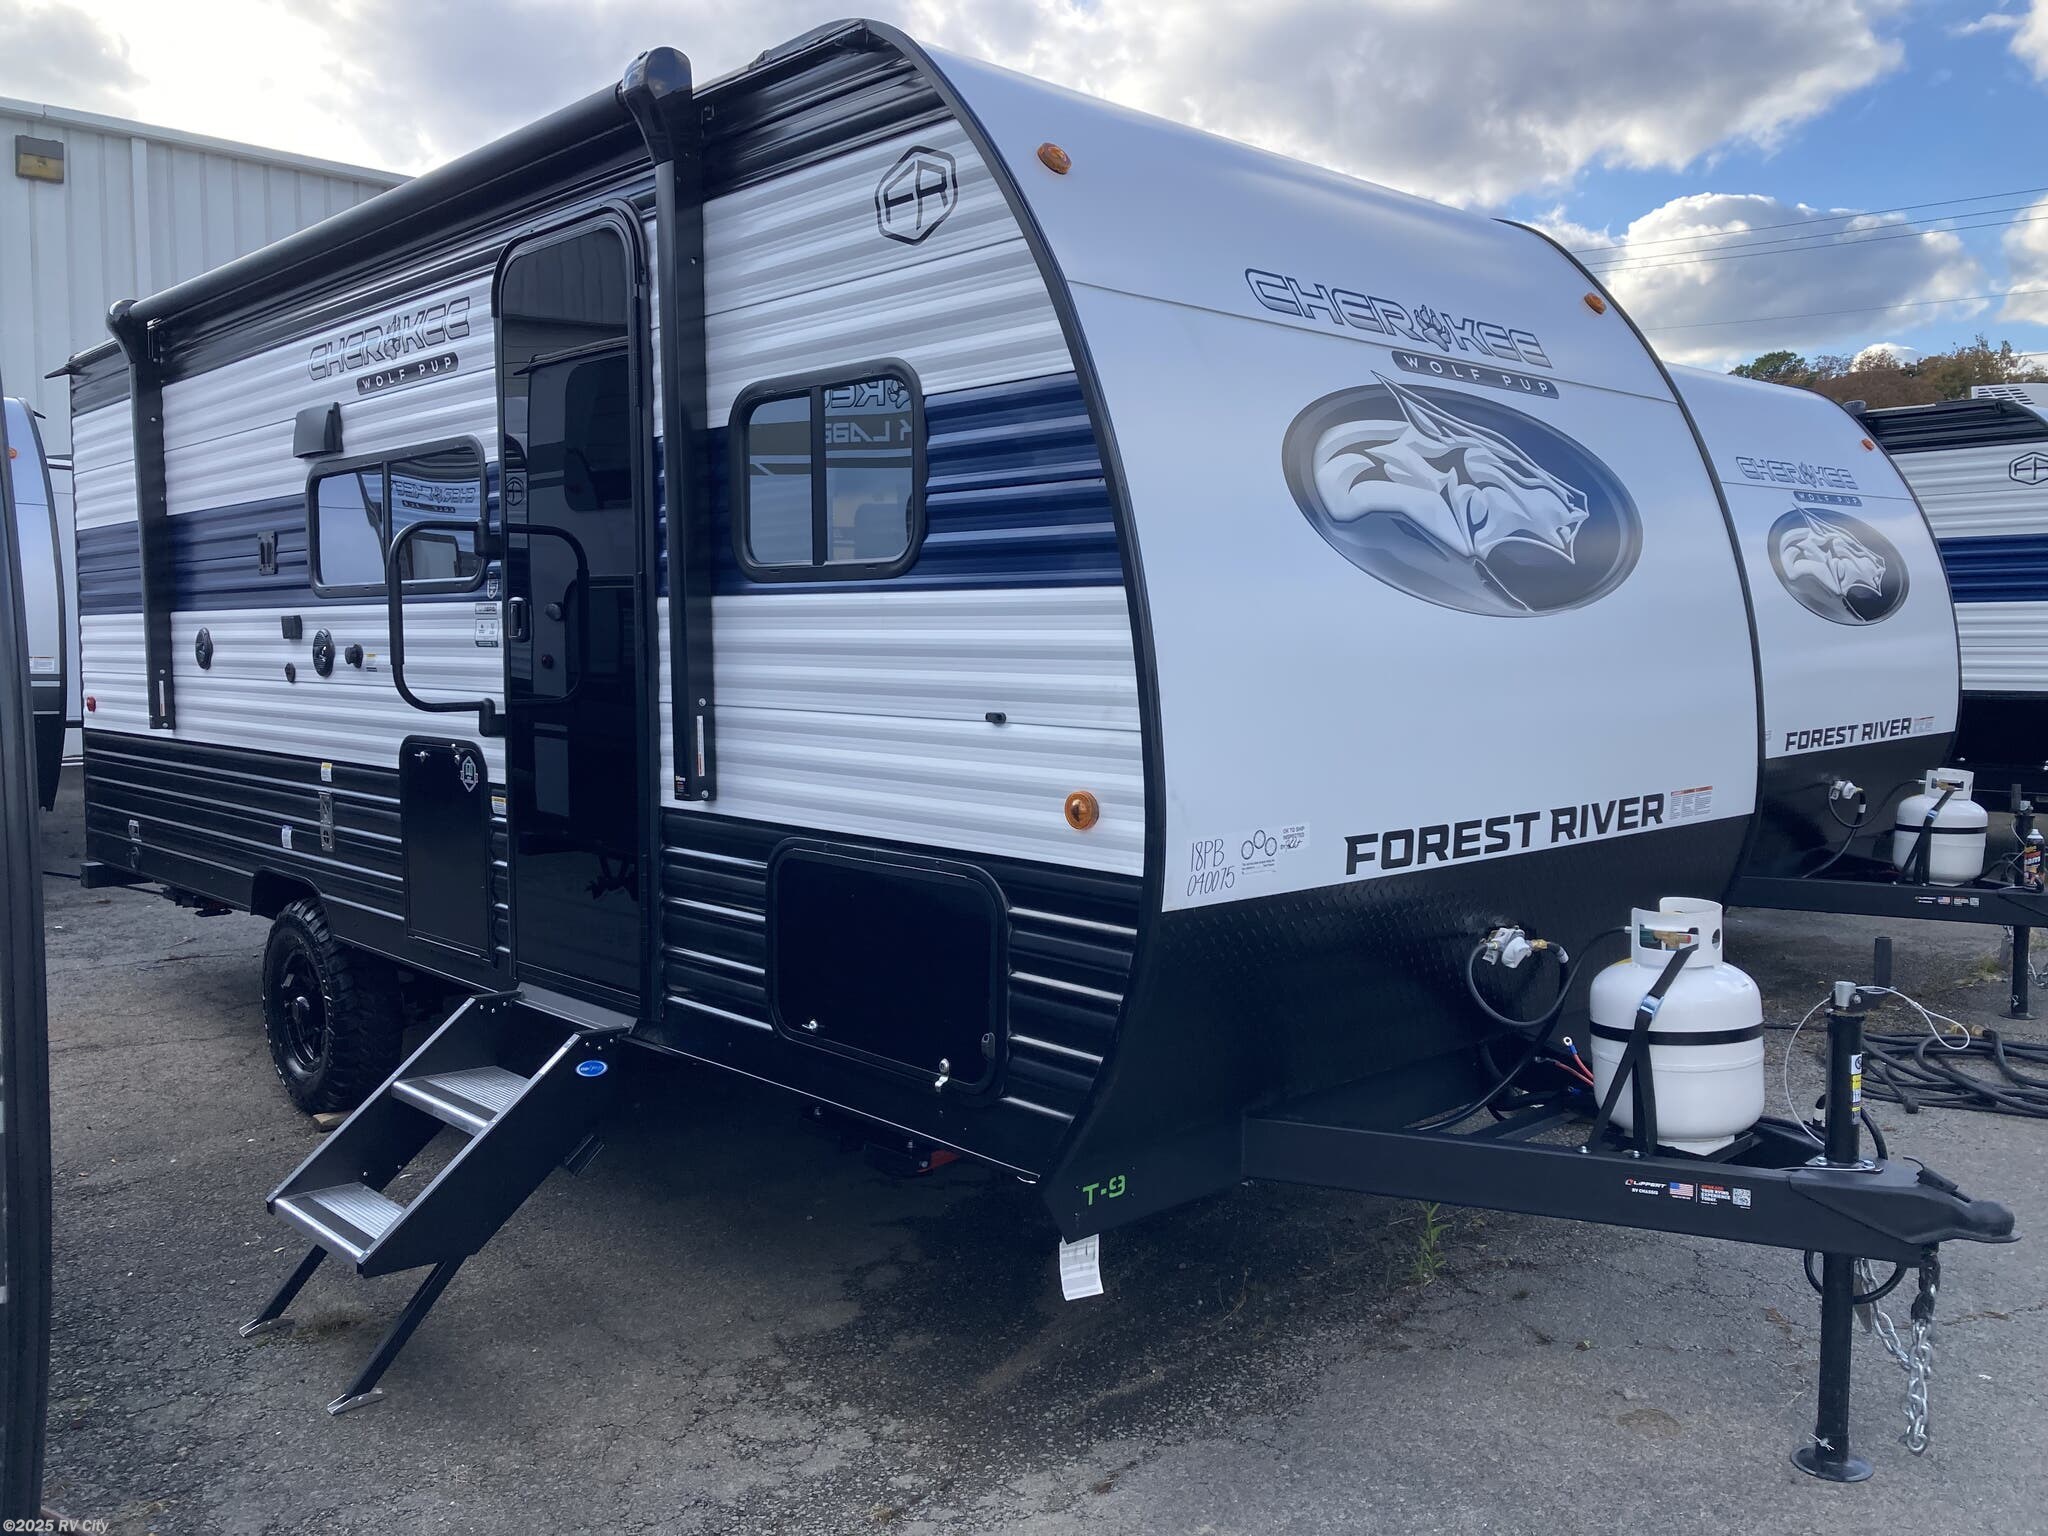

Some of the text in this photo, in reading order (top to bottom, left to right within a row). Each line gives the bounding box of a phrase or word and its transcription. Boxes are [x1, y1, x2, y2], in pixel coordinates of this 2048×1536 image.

[1245, 268, 1553, 369] CHEROKEE
[308, 296, 471, 381] CHEROKEE
[362, 357, 452, 390] WOLF PUP
[1403, 354, 1549, 394] WOLF PUP
[1736, 456, 1859, 490] CHEROKEE
[1784, 724, 1859, 752] FOREST
[1861, 717, 1912, 742] RIVER
[1344, 811, 1541, 876] FOREST
[1550, 793, 1665, 844] RIVER
[1191, 838, 1225, 873] 18PB
[1187, 866, 1236, 897] 040075
[1082, 1174, 1126, 1206] T-9
